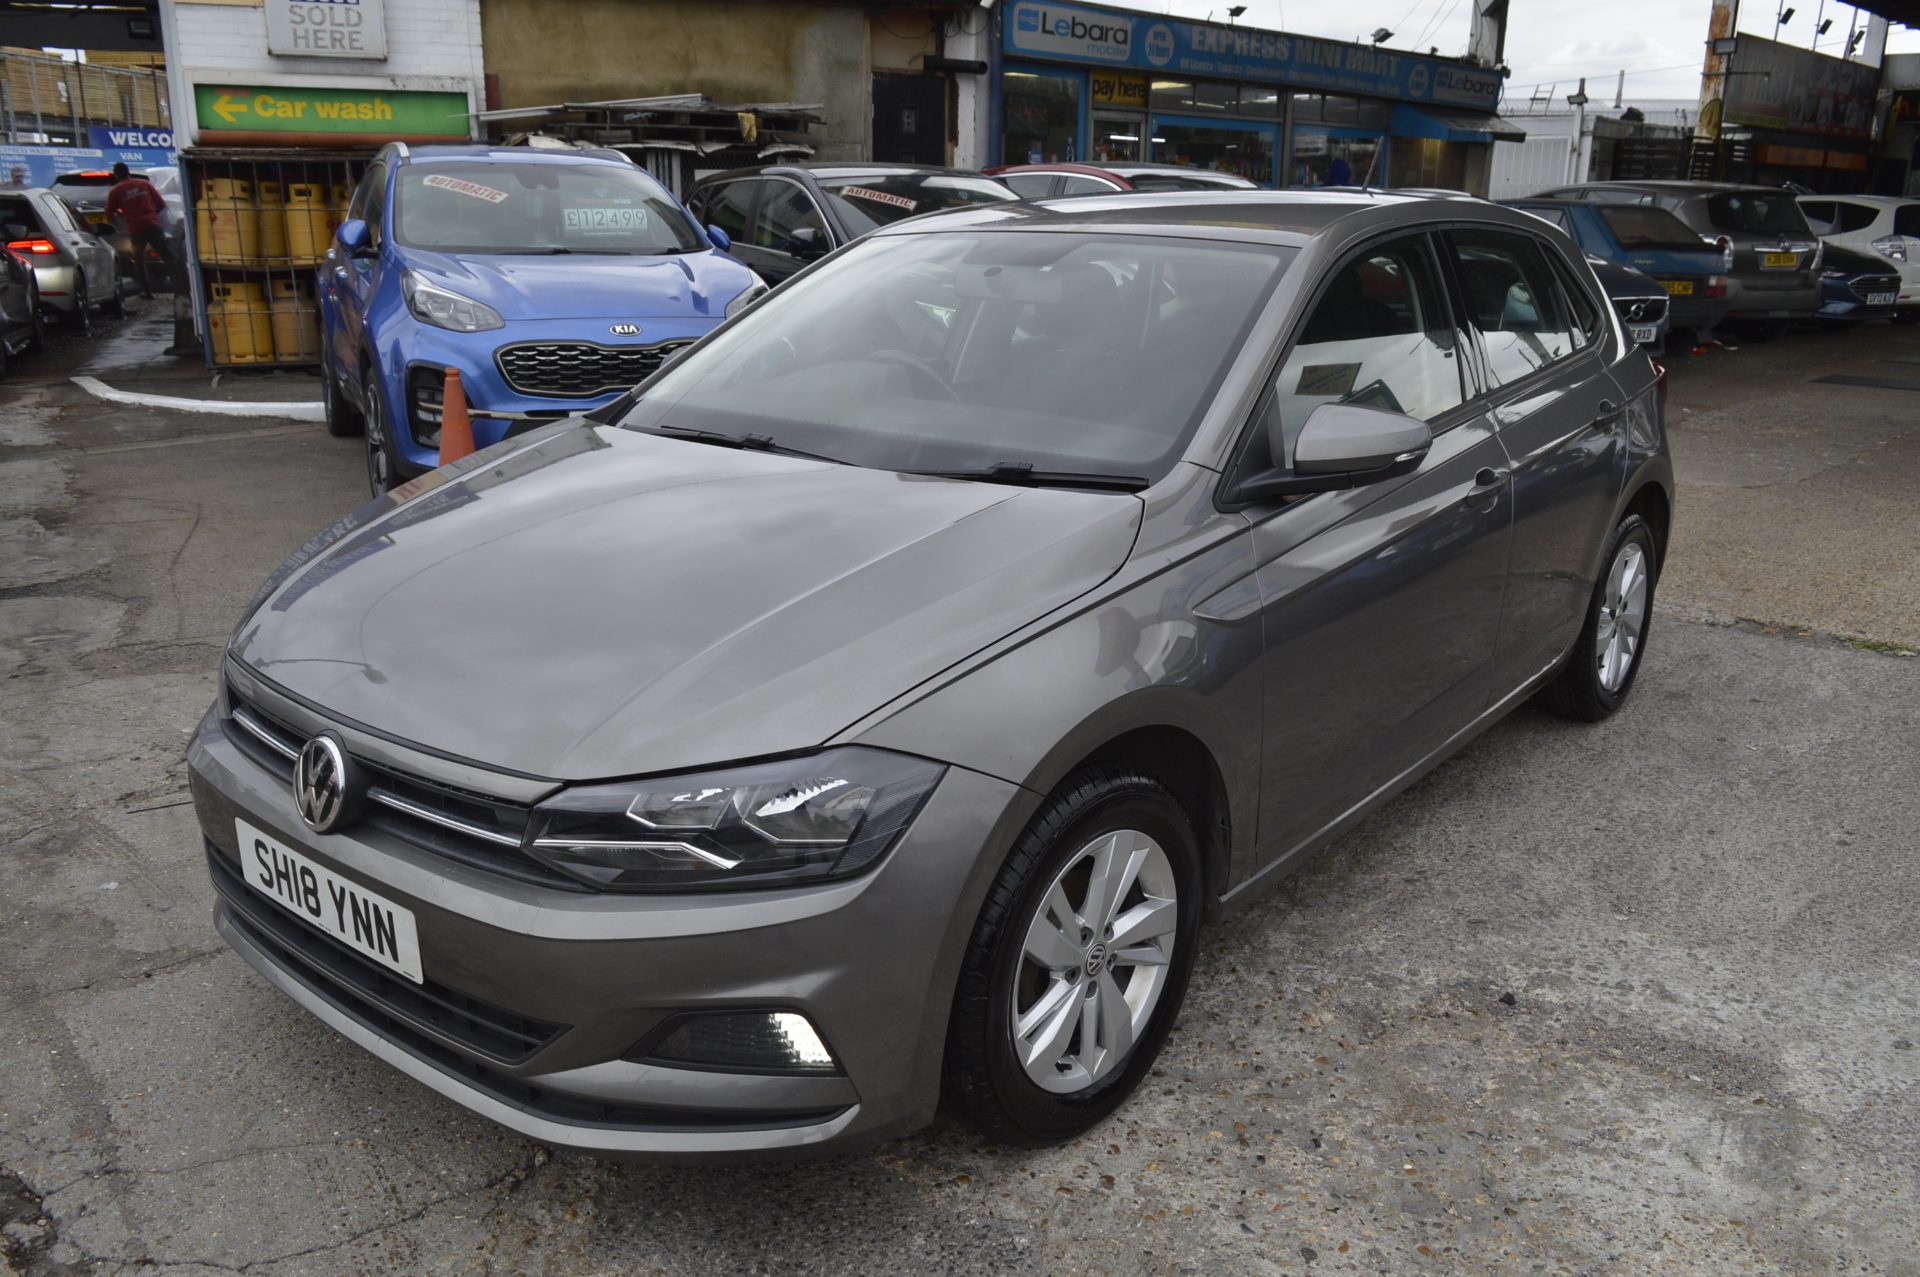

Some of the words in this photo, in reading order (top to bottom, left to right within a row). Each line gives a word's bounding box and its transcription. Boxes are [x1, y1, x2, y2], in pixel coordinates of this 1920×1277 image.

[289, 5, 363, 28] SOLD
[1041, 11, 1128, 45] Lebara
[292, 28, 364, 51] HERE
[1088, 43, 1126, 57] mobile
[1191, 25, 1290, 61] EXPRESS
[1295, 39, 1343, 69] MINI
[1346, 46, 1400, 77] MART
[1092, 78, 1116, 101] pay
[1118, 76, 1147, 97] here
[1447, 73, 1496, 95] Lebara
[254, 95, 307, 119] Car
[314, 98, 393, 121] wash
[109, 131, 176, 147] WELCO
[120, 152, 143, 161] VAN
[429, 175, 503, 200] AUTOMATIC
[847, 186, 911, 208] AUTOMATIC
[614, 324, 638, 334] KIA
[1637, 329, 1652, 341] RXD
[254, 838, 321, 919] SH18
[327, 878, 400, 964] YNN
